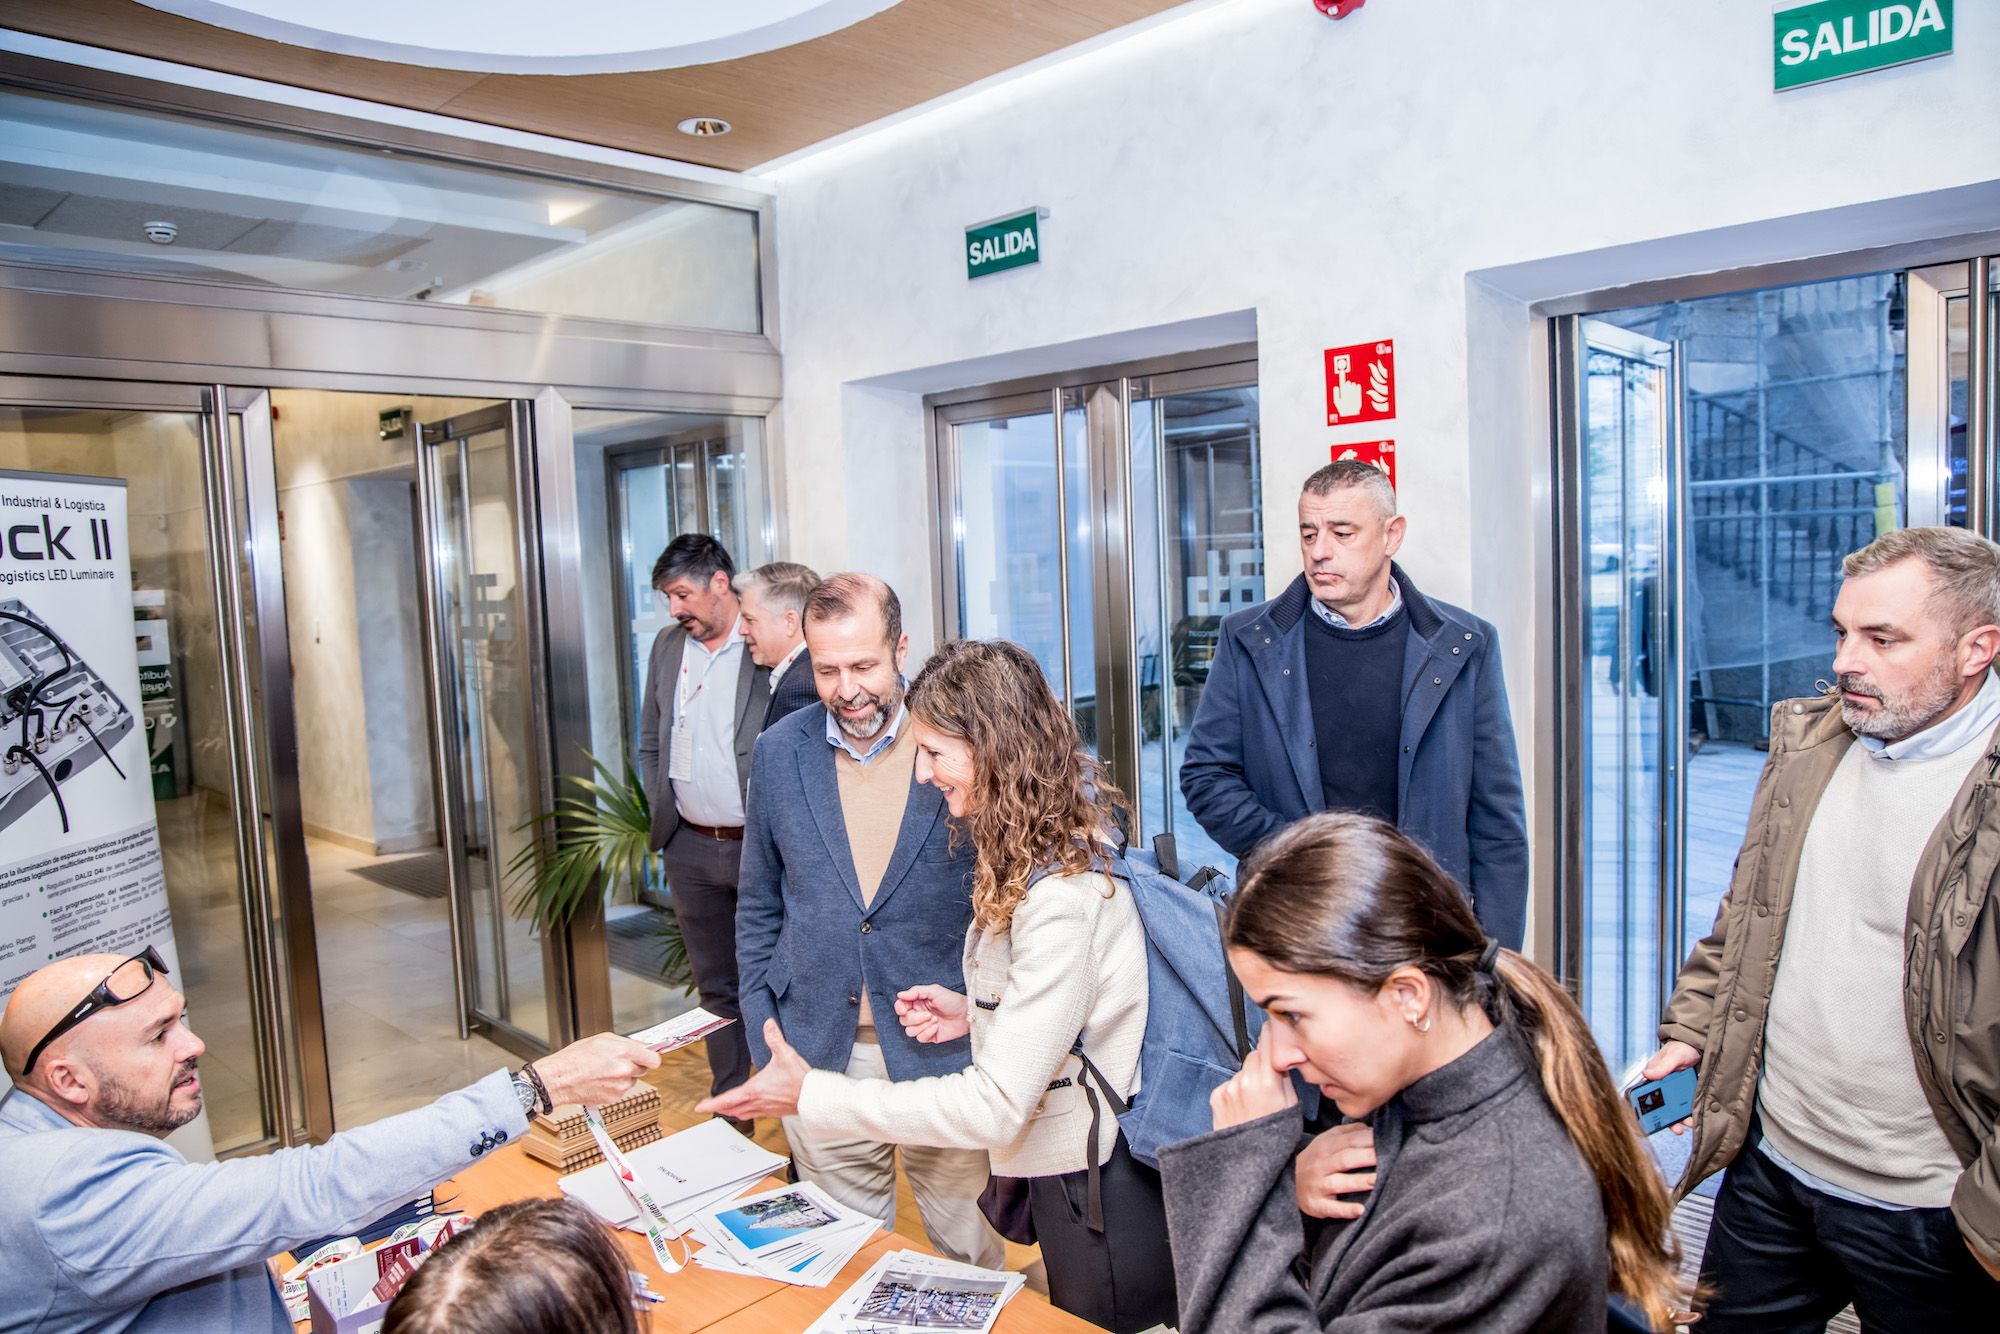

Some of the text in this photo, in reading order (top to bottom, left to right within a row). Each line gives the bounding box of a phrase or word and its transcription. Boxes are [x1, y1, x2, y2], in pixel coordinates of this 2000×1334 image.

[1780, 0, 1946, 66] SALIDA
[969, 227, 1036, 266] SALIDA
[1, 494, 51, 508] Industrial
[54, 498, 62, 509] &
[48, 569, 67, 581] LED
[70, 568, 115, 580] Luminaire
[60, 849, 87, 860] espacios
[60, 856, 94, 871] multicliente
[95, 852, 107, 860] con
[65, 892, 105, 911] programación
[16, 935, 36, 945] Rango
[652, 1233, 671, 1264] liderled
